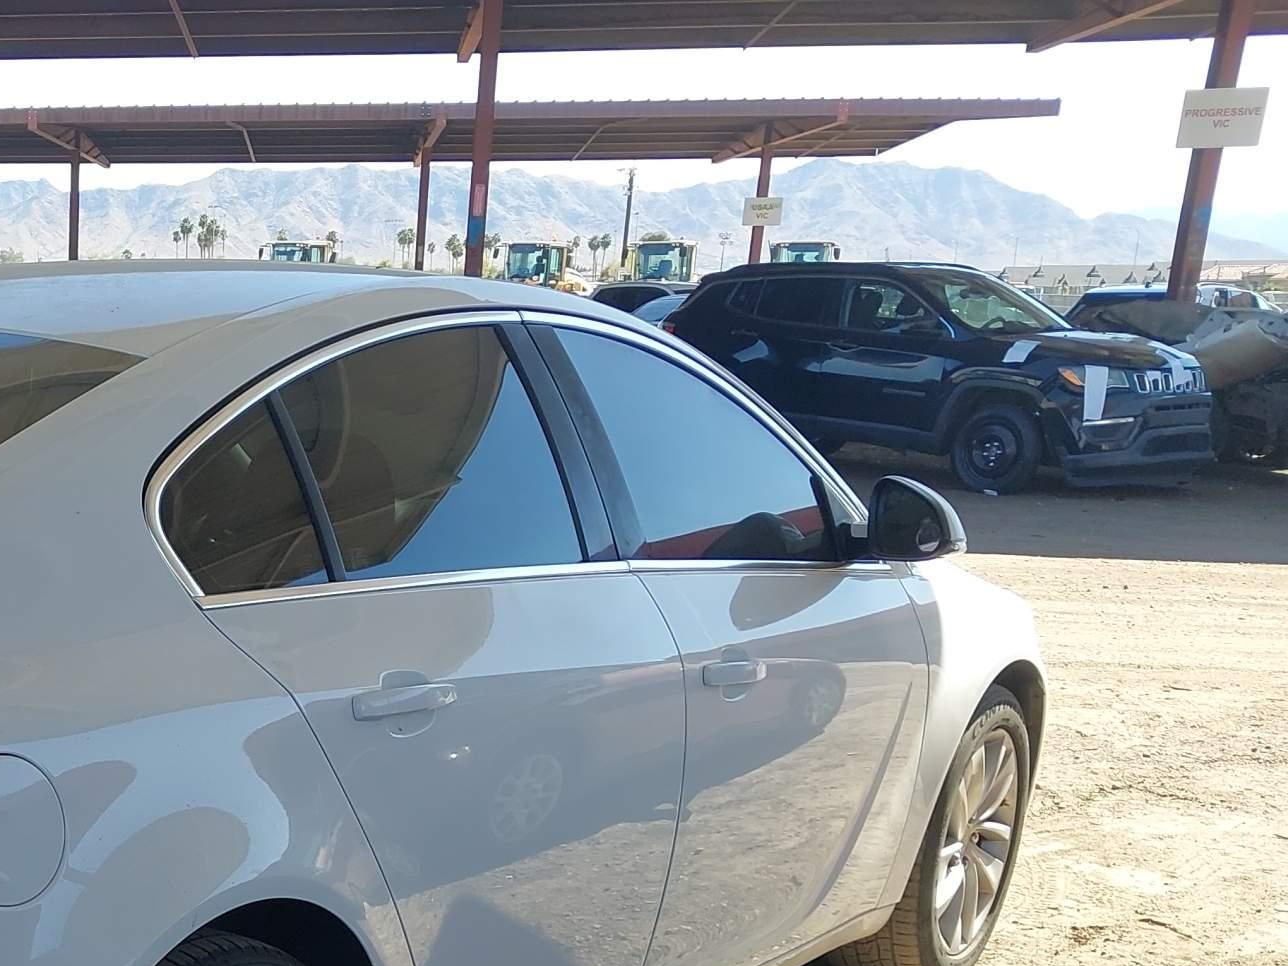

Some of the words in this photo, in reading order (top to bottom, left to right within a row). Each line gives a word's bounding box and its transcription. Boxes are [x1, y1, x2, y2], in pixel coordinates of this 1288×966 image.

[1184, 106, 1262, 117] PROGRESSIVE
[1212, 119, 1231, 128] VIC
[756, 212, 769, 220] VIC
